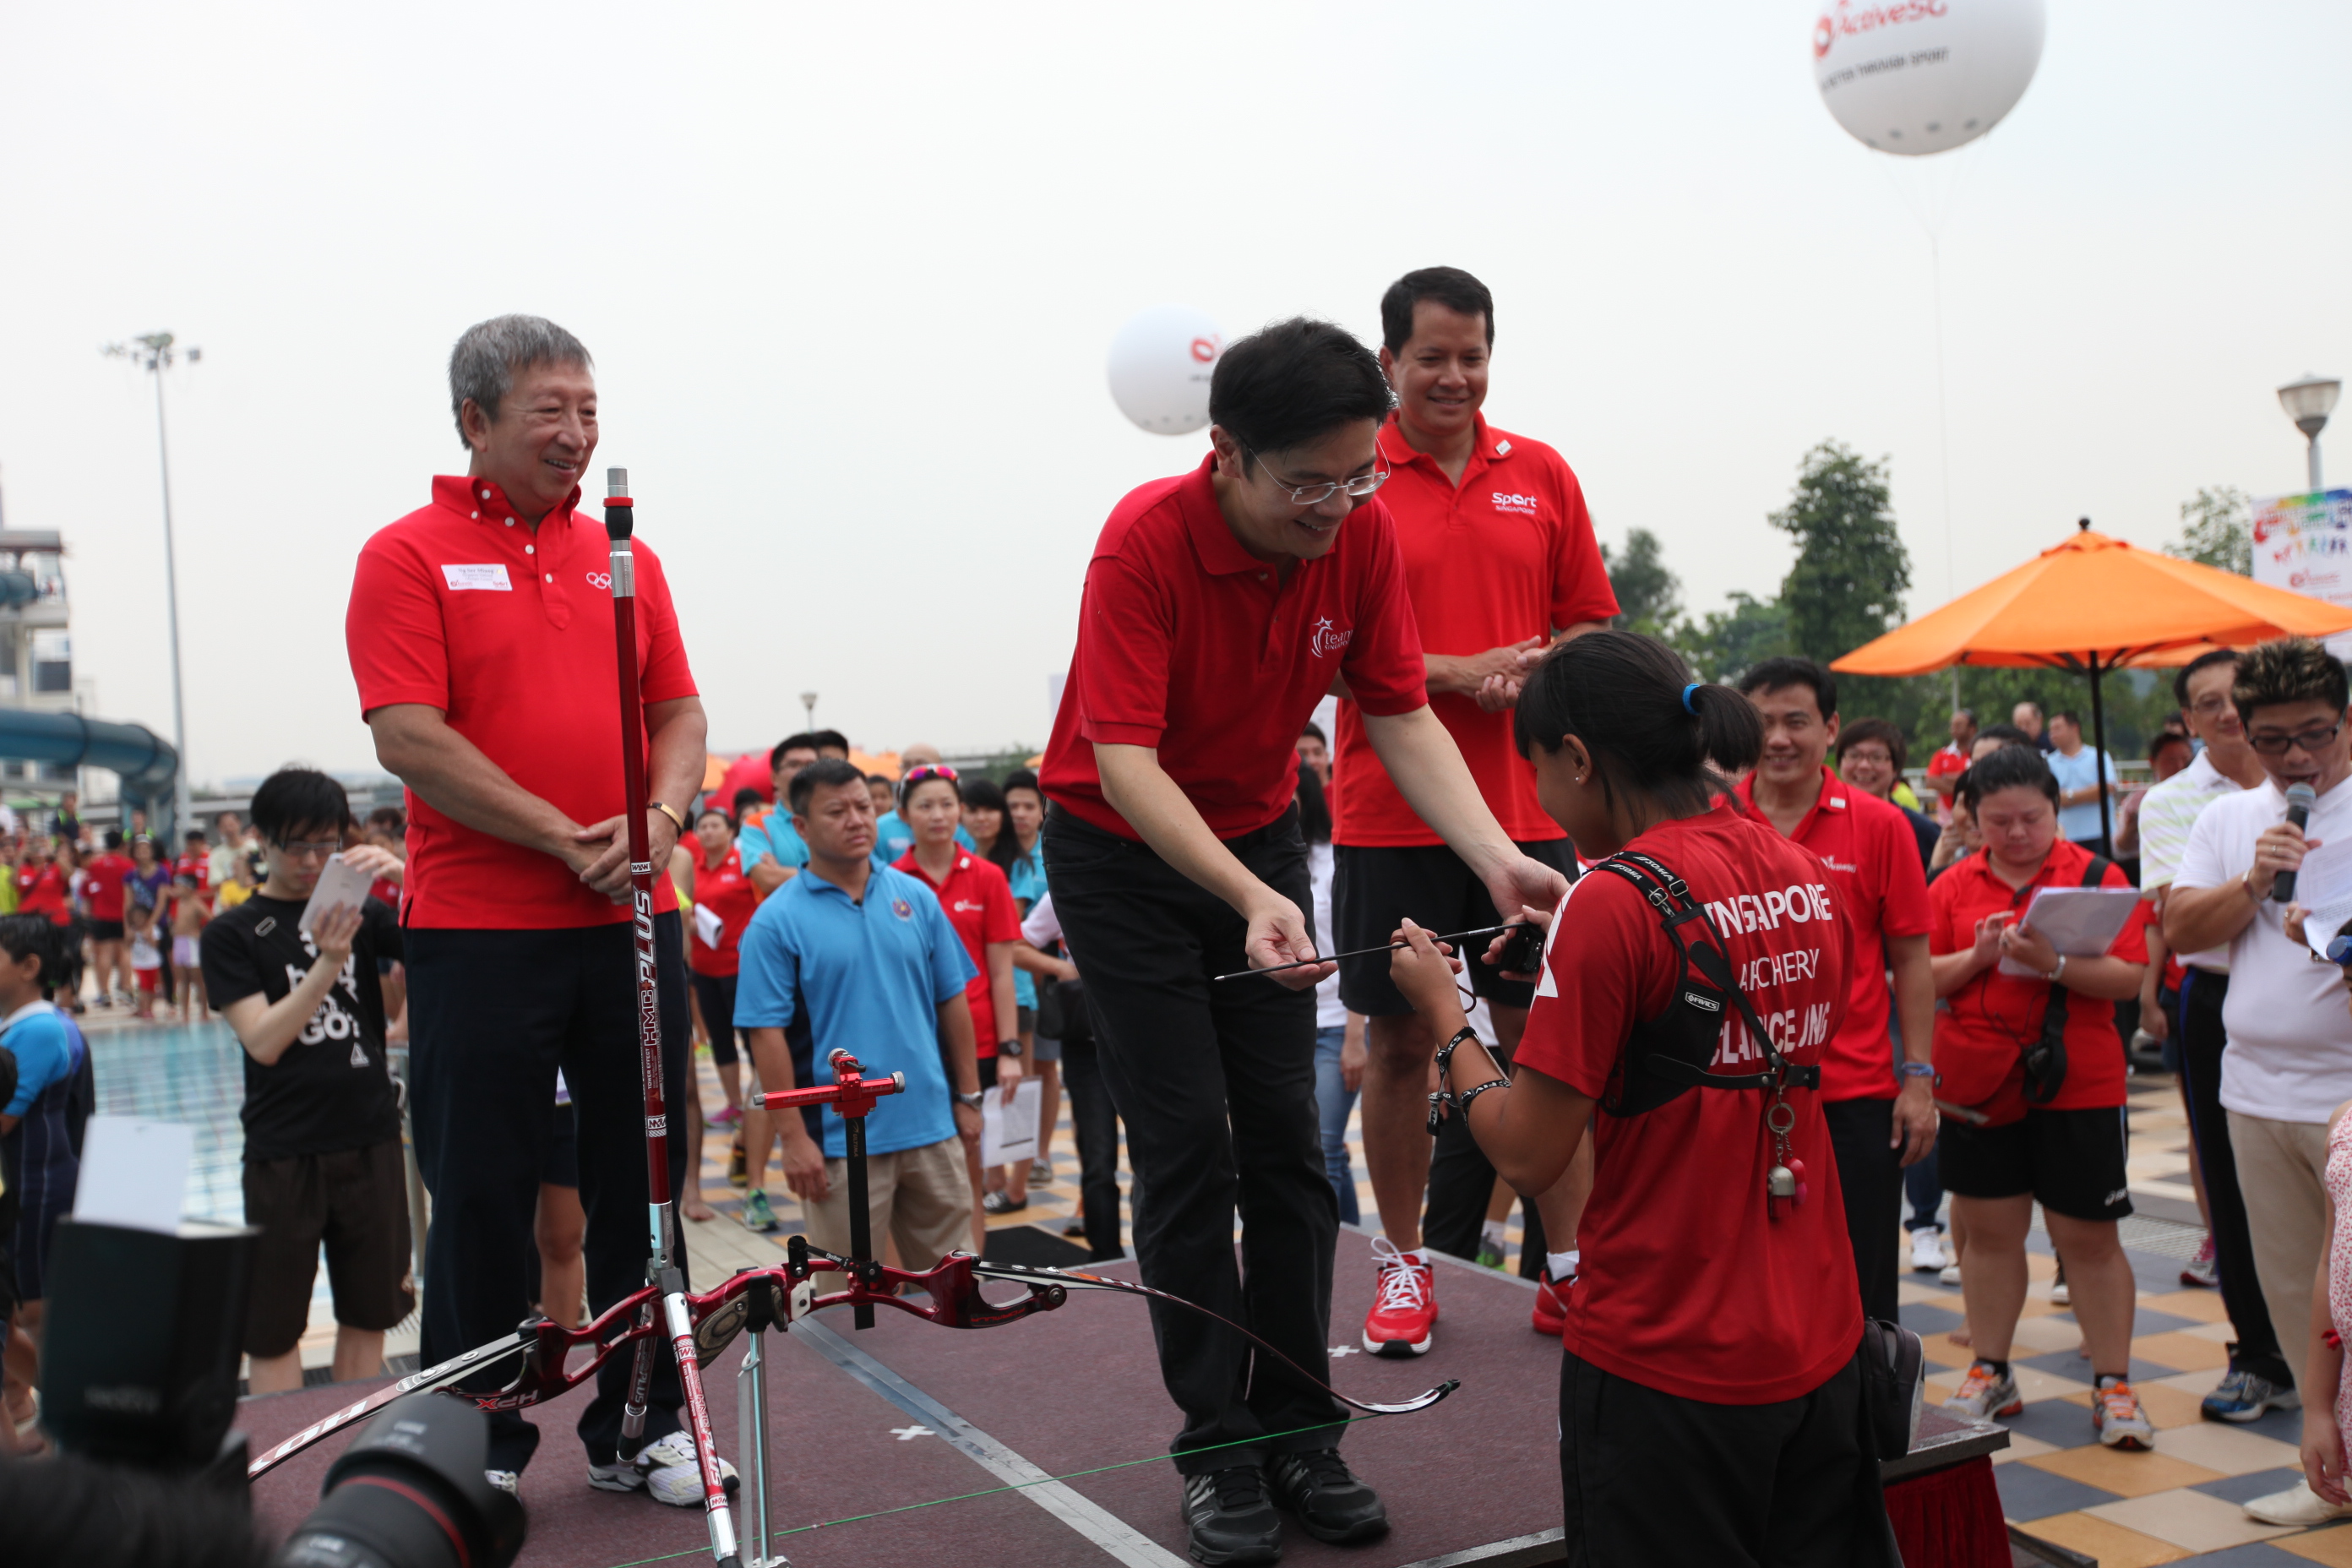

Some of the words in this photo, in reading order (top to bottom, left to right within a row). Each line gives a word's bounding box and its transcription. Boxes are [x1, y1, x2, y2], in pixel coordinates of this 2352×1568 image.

[1491, 493, 1537, 508] Sport
[1495, 505, 1536, 515] SINGAPORE
[633, 885, 656, 989] PLUS
[640, 989, 656, 1046] HMC
